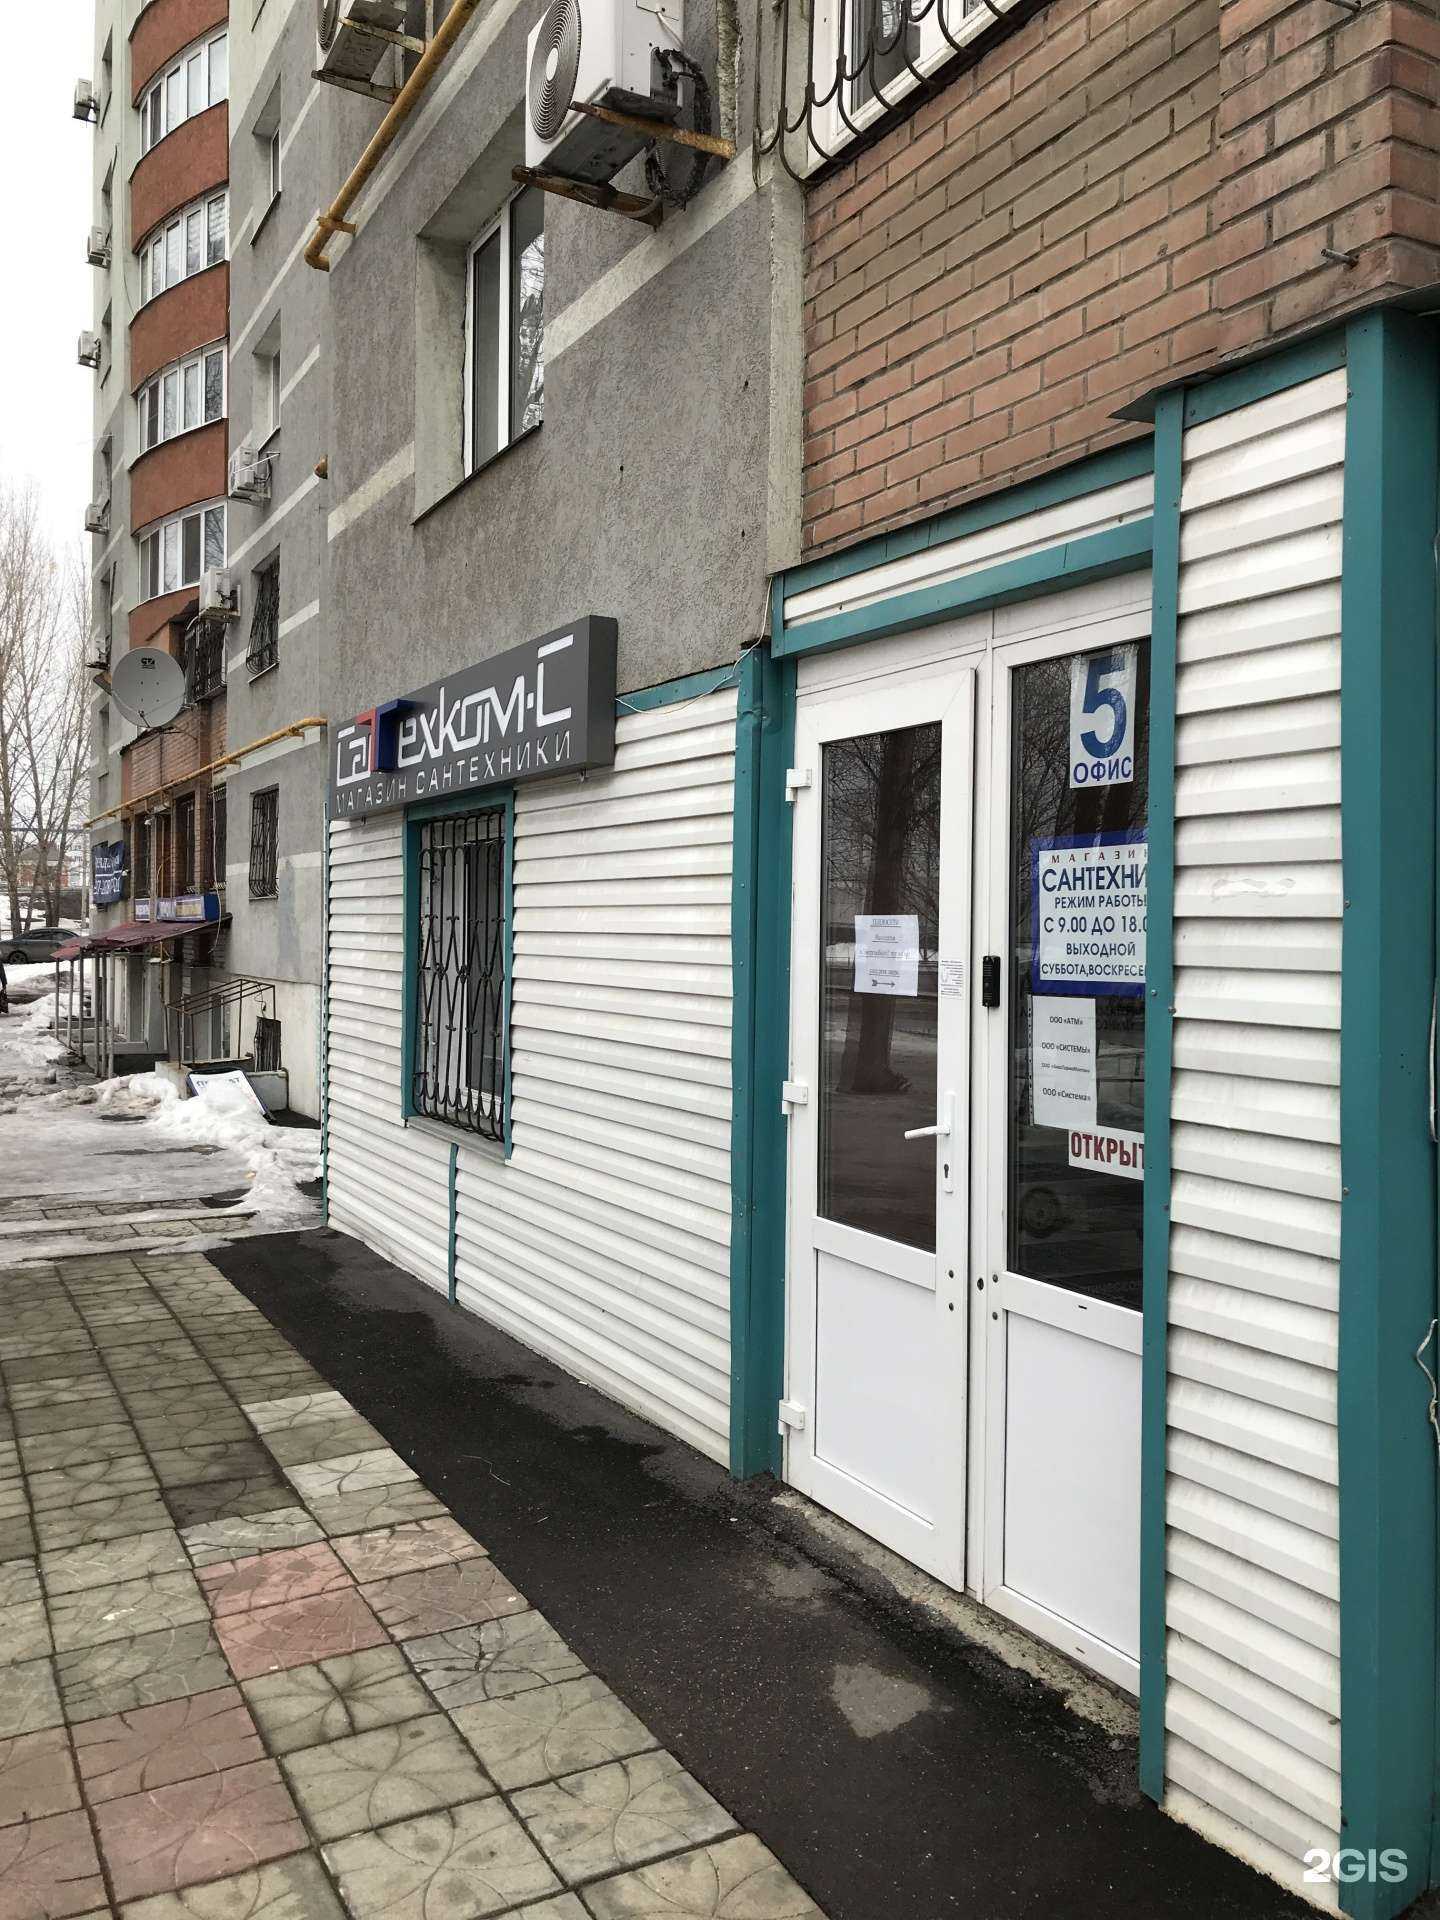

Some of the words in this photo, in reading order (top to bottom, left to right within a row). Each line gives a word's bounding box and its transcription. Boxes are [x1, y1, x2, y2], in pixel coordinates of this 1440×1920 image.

[1081, 655, 1127, 758] 5
[336, 776, 407, 814] МАГАЗИН
[416, 731, 571, 794] САНТЕХНИКИ
[1073, 756, 1132, 783] ОФИС
[1042, 864, 1147, 892] САНТЕХНИ
[1055, 896, 1095, 909] РЕЖИМ
[1098, 894, 1147, 908] РАБОТЫ
[1044, 917, 1054, 933] С
[1059, 916, 1087, 933] 9.00
[1091, 916, 1115, 935] ДО
[1121, 915, 1147, 933] 18.0
[1066, 941, 1136, 957] ВЫХОДНОЙ
[1041, 963, 1147, 978] СУББОТА,ВОСКРЕСЕ
[1049, 1016, 1063, 1024] ООО
[1041, 1042, 1055, 1050] ООО
[1042, 1087, 1057, 1097] ООО
[1071, 1132, 1145, 1169] ОТКРЫТ
